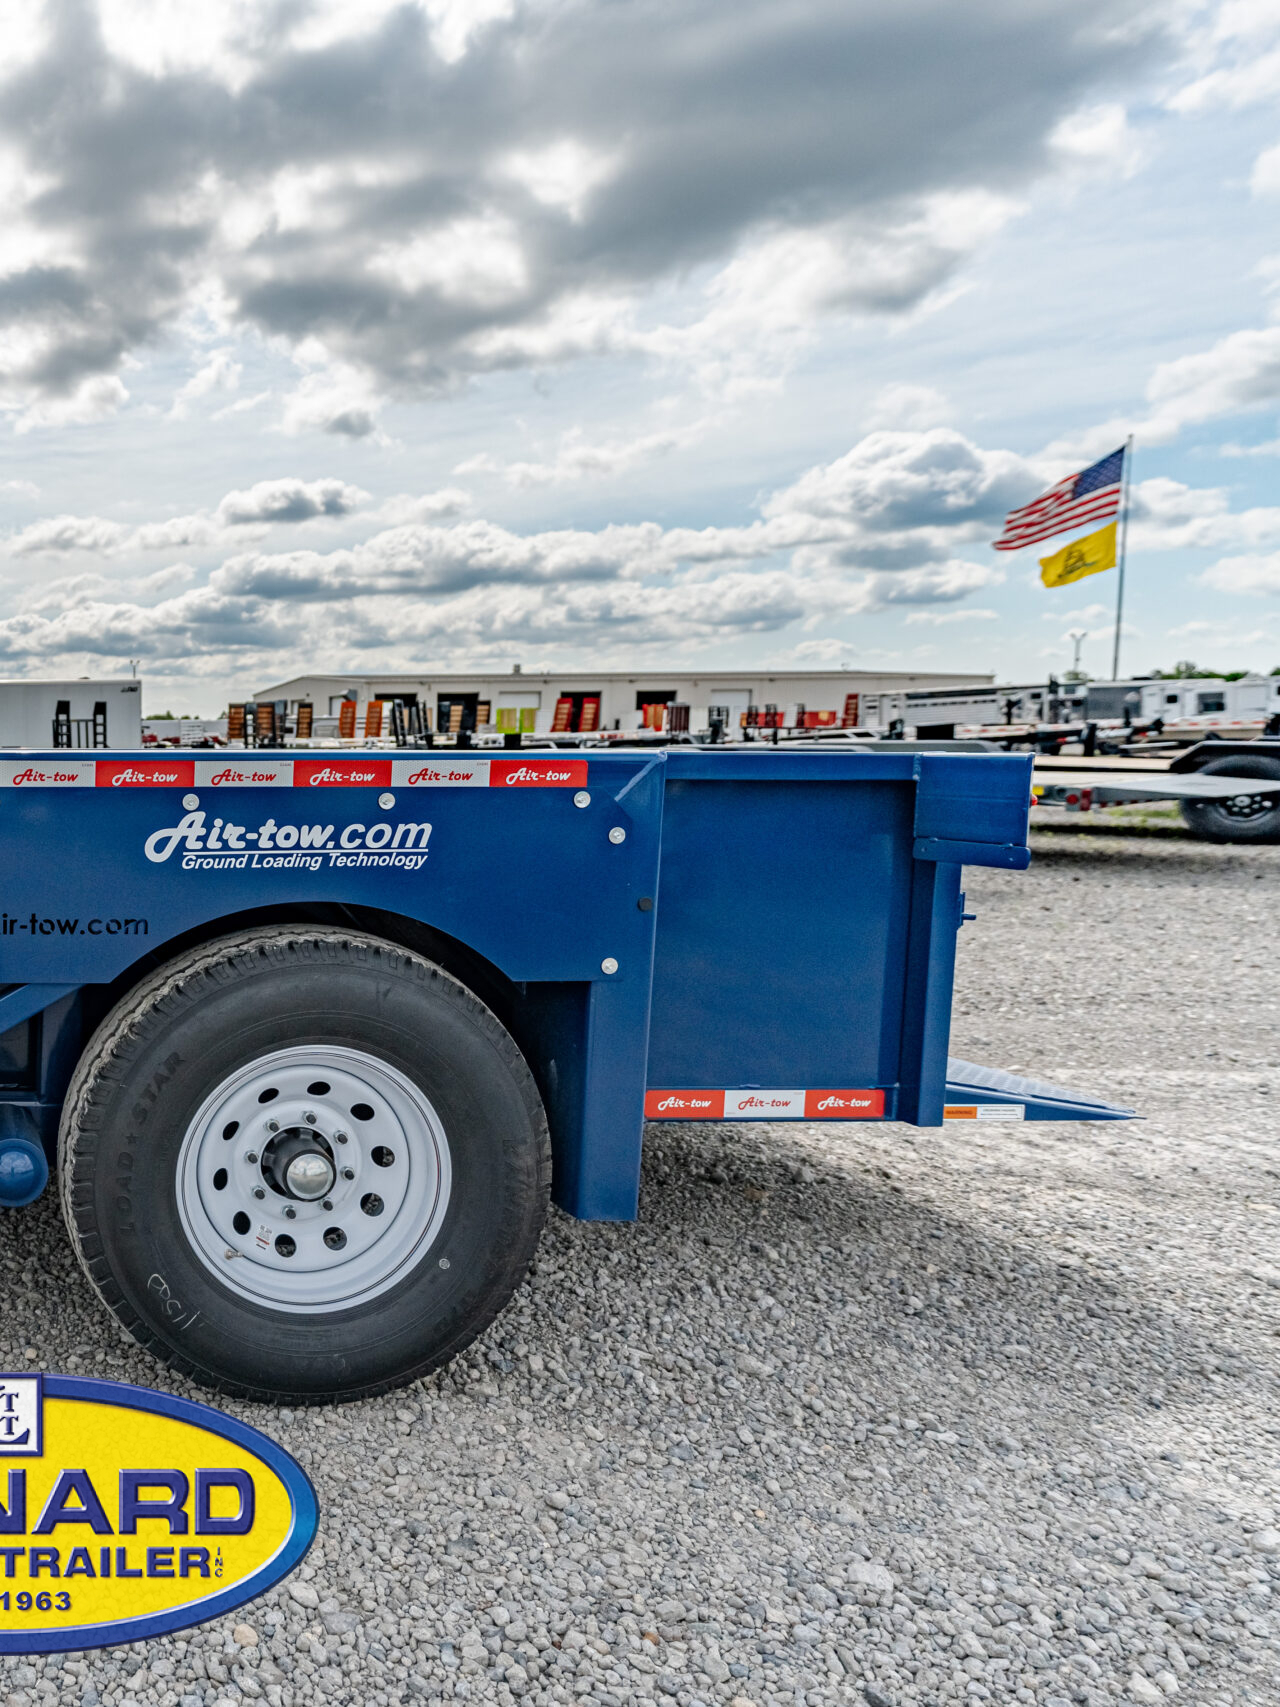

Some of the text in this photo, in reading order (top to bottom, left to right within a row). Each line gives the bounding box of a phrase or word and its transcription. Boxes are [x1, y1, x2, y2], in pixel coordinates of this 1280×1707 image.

[12, 768, 79, 786] Air-tow
[111, 768, 178, 786] Air-tow
[211, 768, 277, 786] Air-tow
[309, 768, 376, 786] Air-tow
[408, 767, 474, 785] Air-tow
[505, 767, 572, 785] Air-tow
[144, 810, 433, 863] Air-tow.com
[181, 852, 429, 871] Ground Loading Technology
[131, 1052, 183, 1126] STAR
[657, 1095, 712, 1111] Air-tow
[737, 1095, 792, 1110] Air-tow
[816, 1095, 872, 1111] Air-tow
